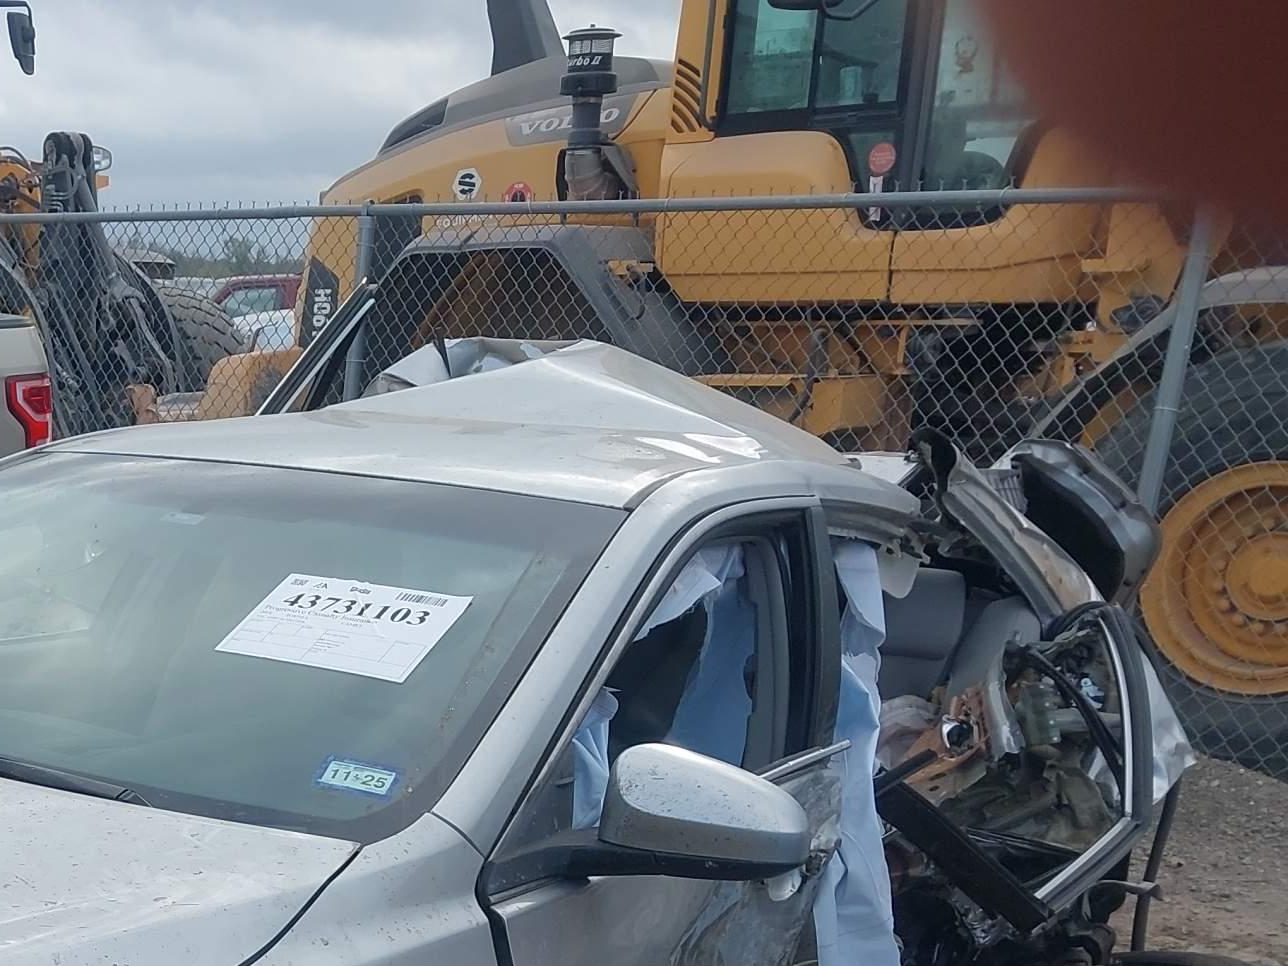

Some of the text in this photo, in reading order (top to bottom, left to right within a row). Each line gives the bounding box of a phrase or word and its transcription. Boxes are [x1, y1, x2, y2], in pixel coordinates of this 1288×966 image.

[520, 108, 620, 135] VOLO
[283, 593, 431, 626] 43731103
[360, 774, 388, 789] 25
